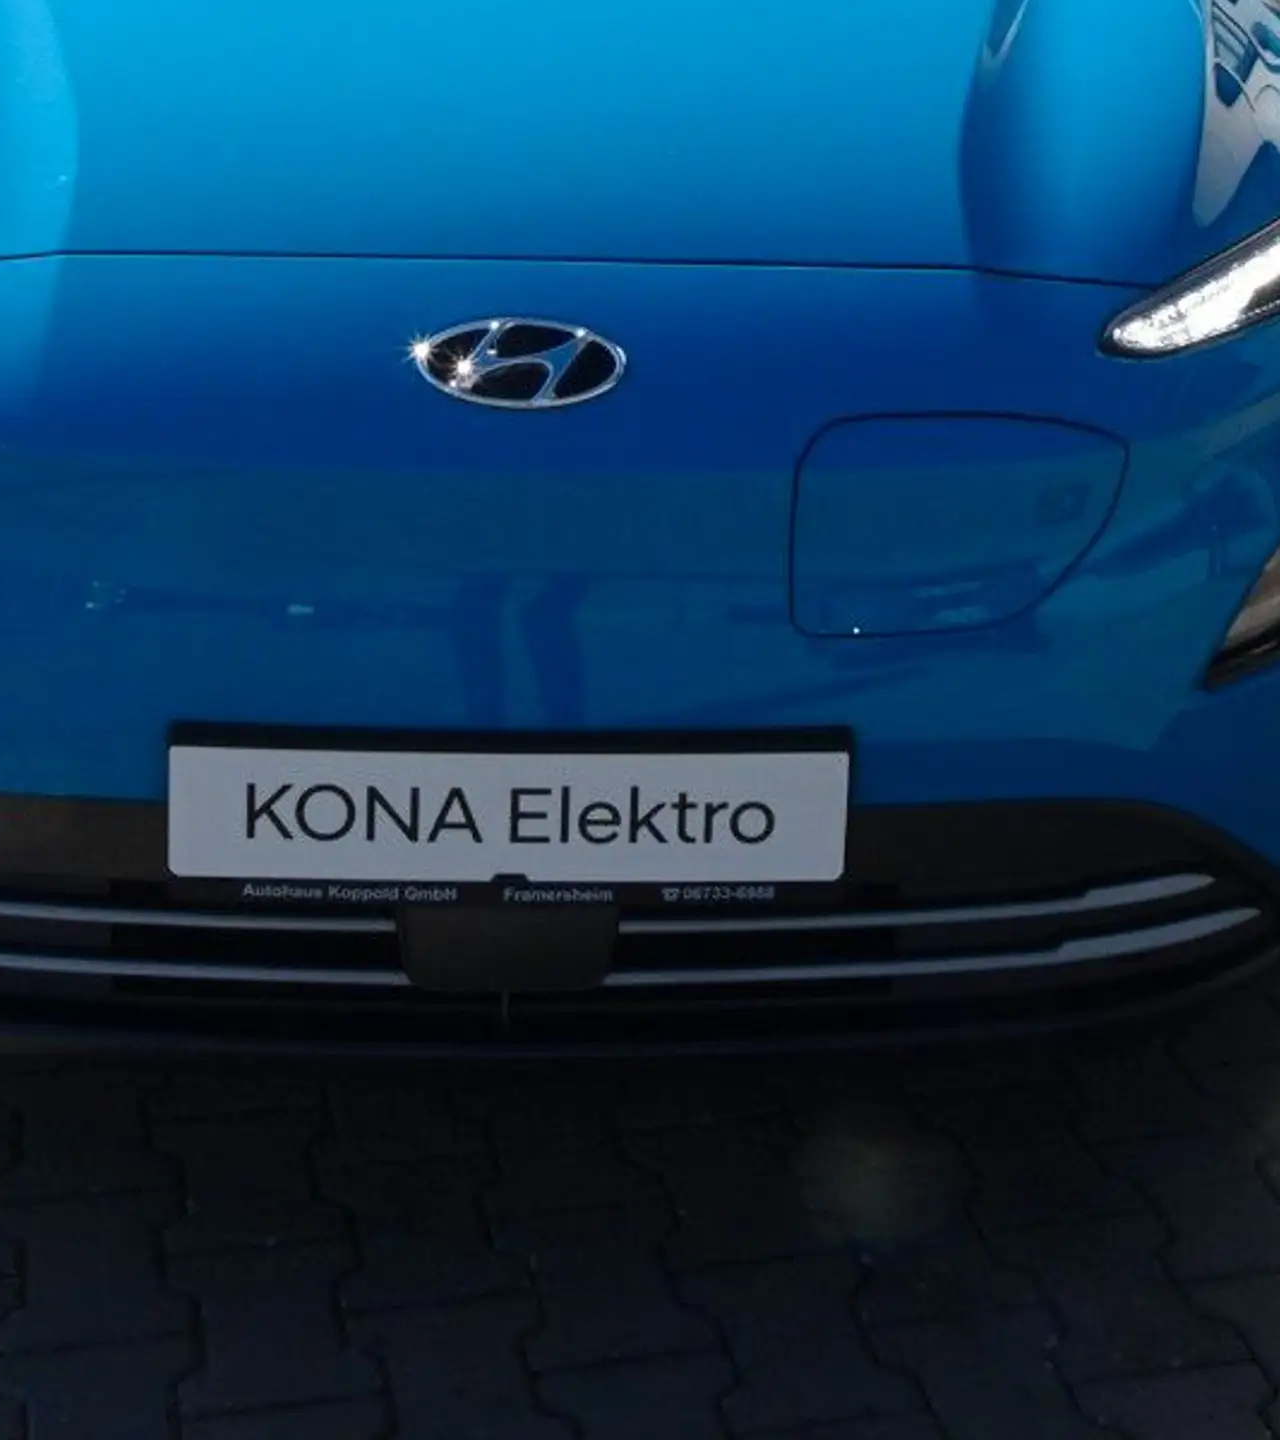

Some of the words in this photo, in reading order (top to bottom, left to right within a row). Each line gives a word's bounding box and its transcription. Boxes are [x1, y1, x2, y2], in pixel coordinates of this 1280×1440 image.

[244, 782, 483, 844] KONA
[509, 785, 776, 845] Elektro
[242, 883, 324, 899] Autohaus
[327, 884, 400, 902] Koppold
[404, 885, 459, 902] GmbH
